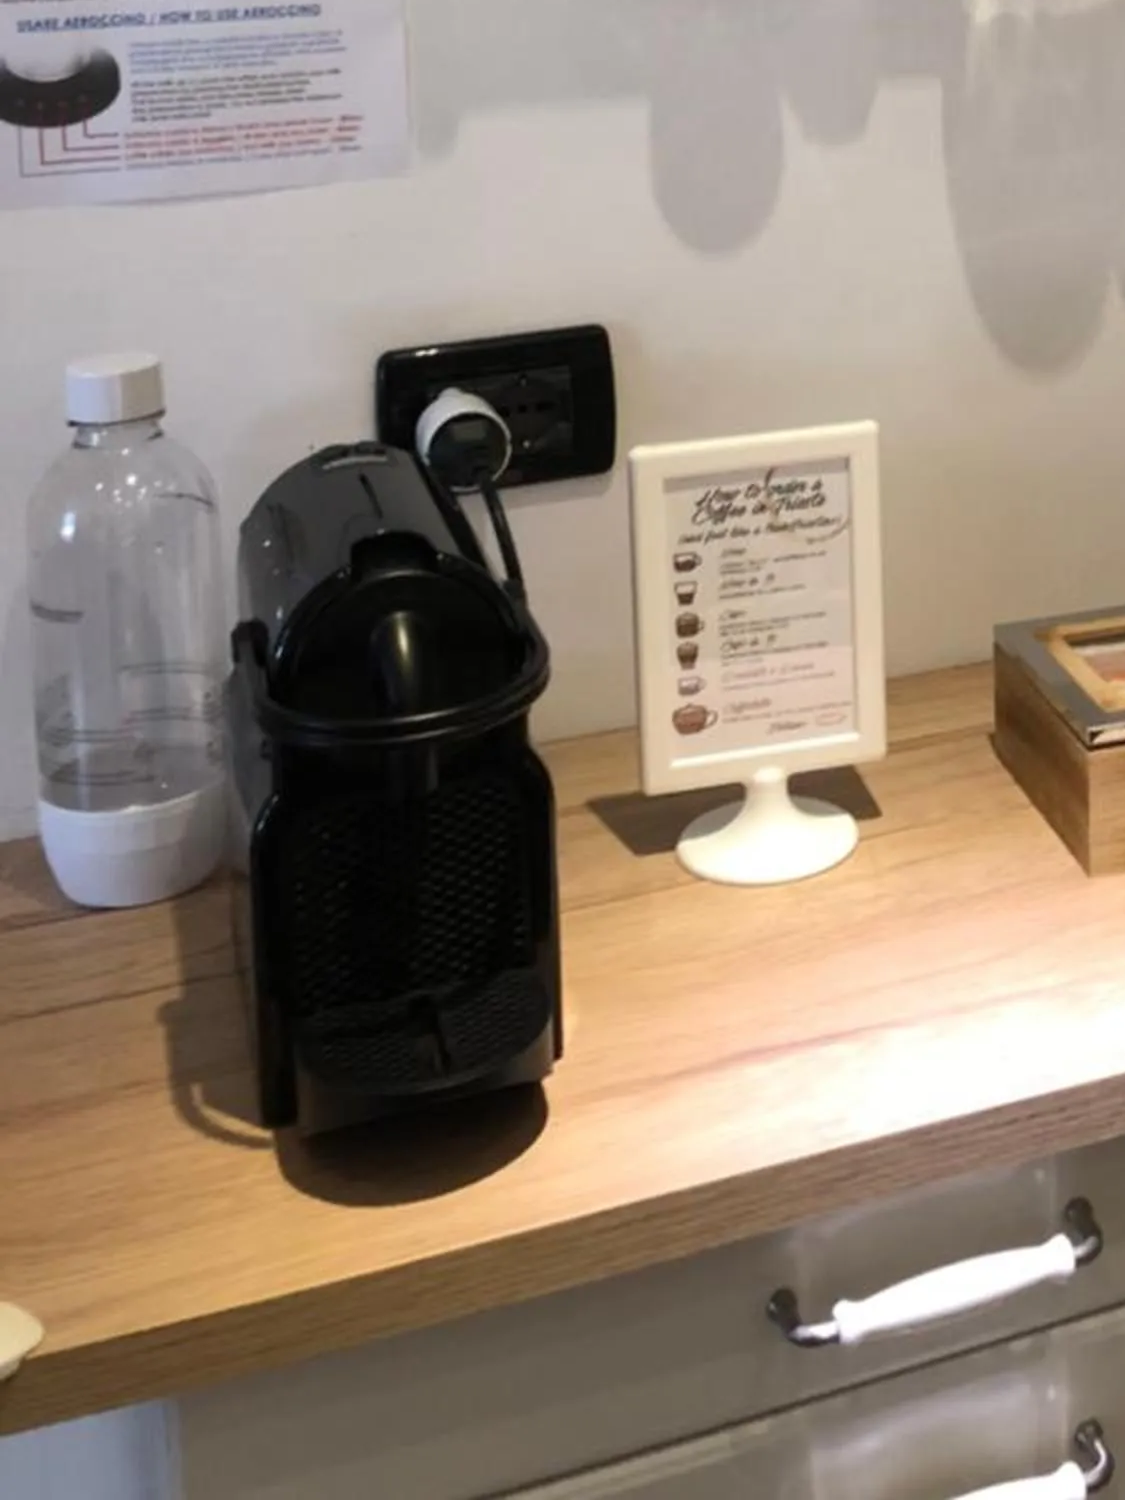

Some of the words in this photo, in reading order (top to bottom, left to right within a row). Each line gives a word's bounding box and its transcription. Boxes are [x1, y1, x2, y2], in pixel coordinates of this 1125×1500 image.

[159, 10, 192, 25] HOW
[195, 9, 212, 23] TO
[216, 8, 242, 22] USE
